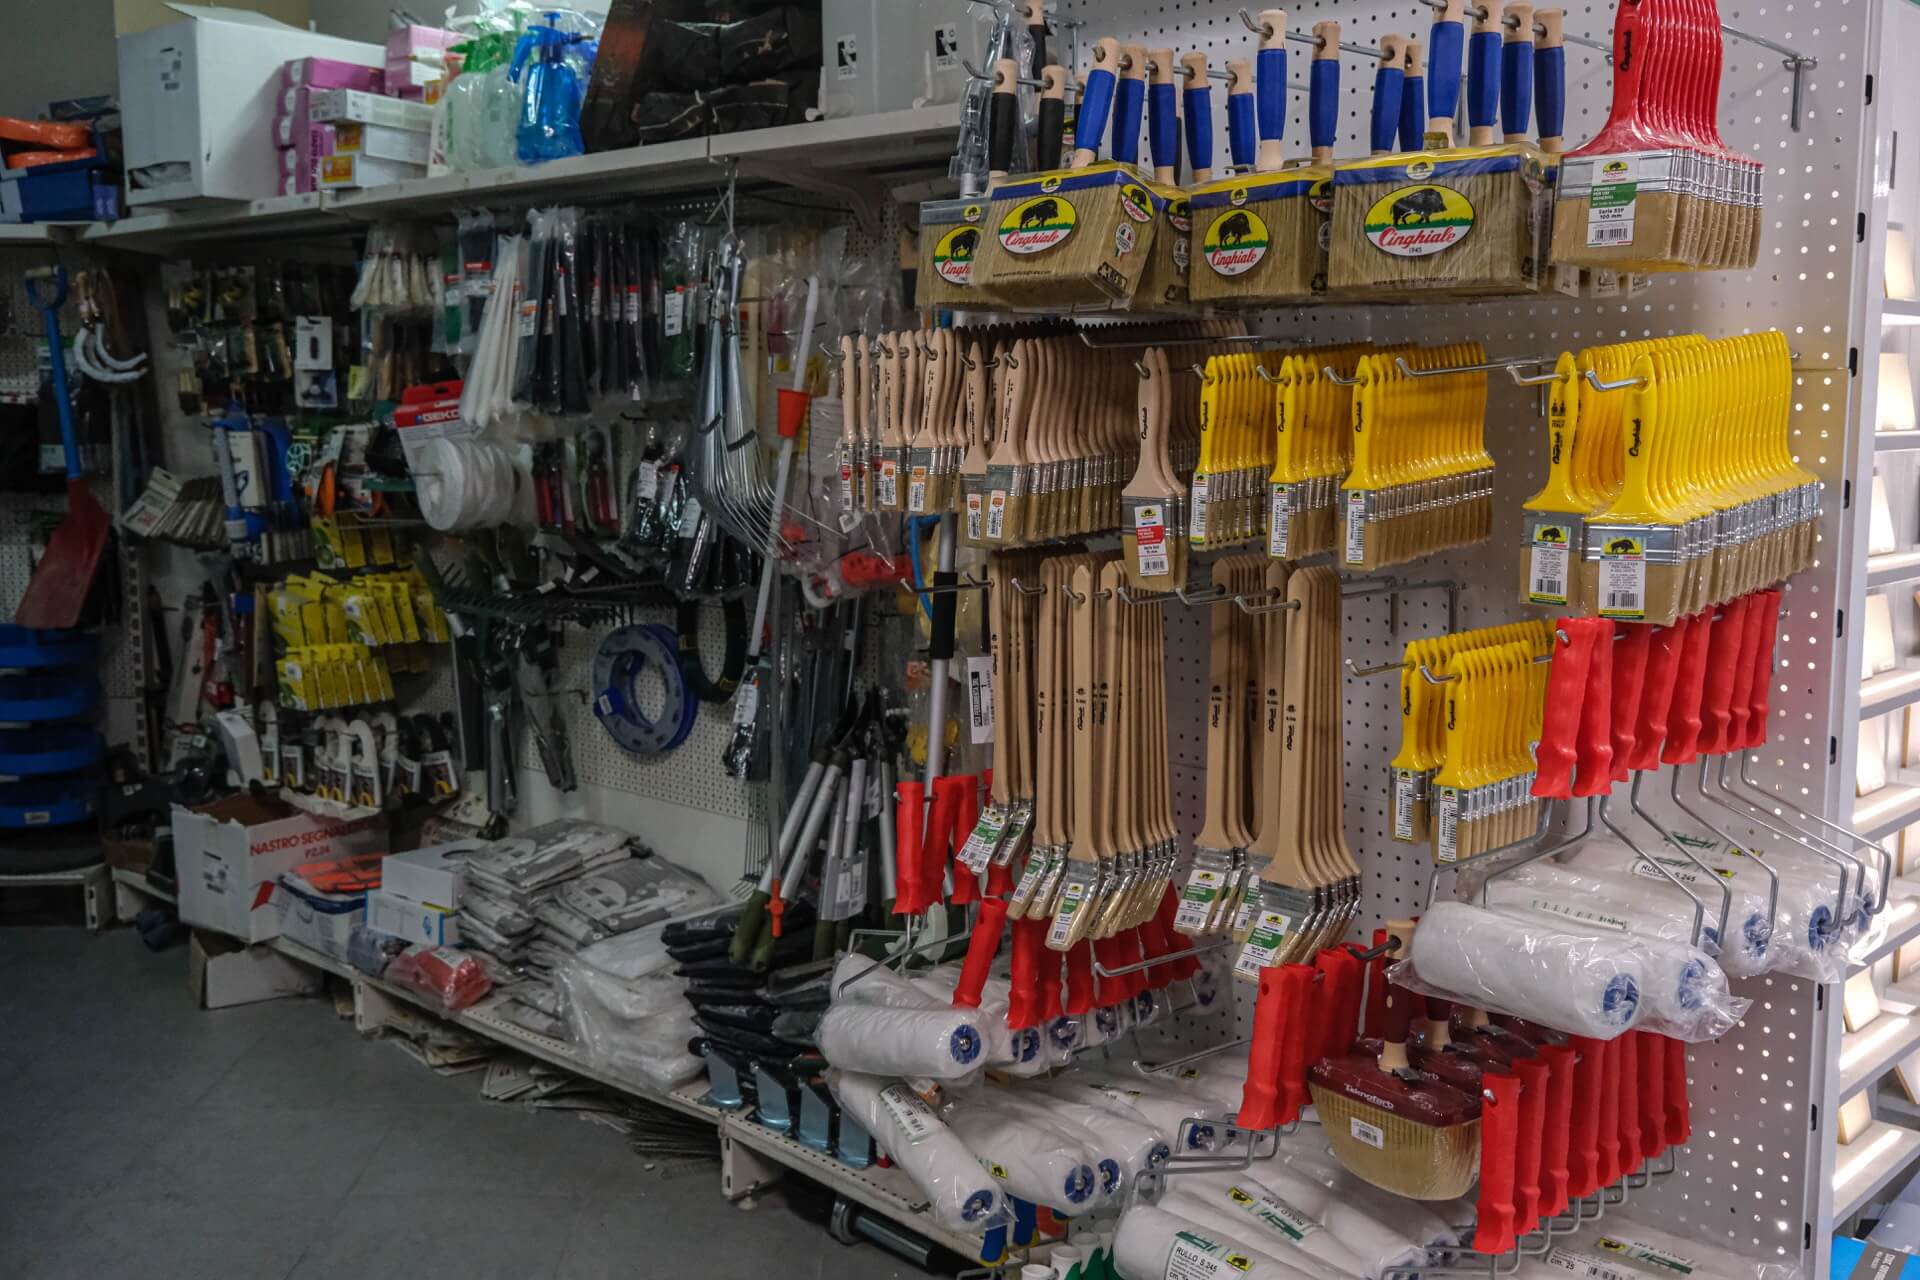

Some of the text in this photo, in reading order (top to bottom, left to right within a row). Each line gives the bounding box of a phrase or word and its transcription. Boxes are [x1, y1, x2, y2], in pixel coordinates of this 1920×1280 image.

[1003, 230, 1060, 248] Cinghiale
[1378, 226, 1456, 249] Cinghiale
[1211, 247, 1258, 267] Cinghiale
[250, 835, 299, 857] NASTRO
